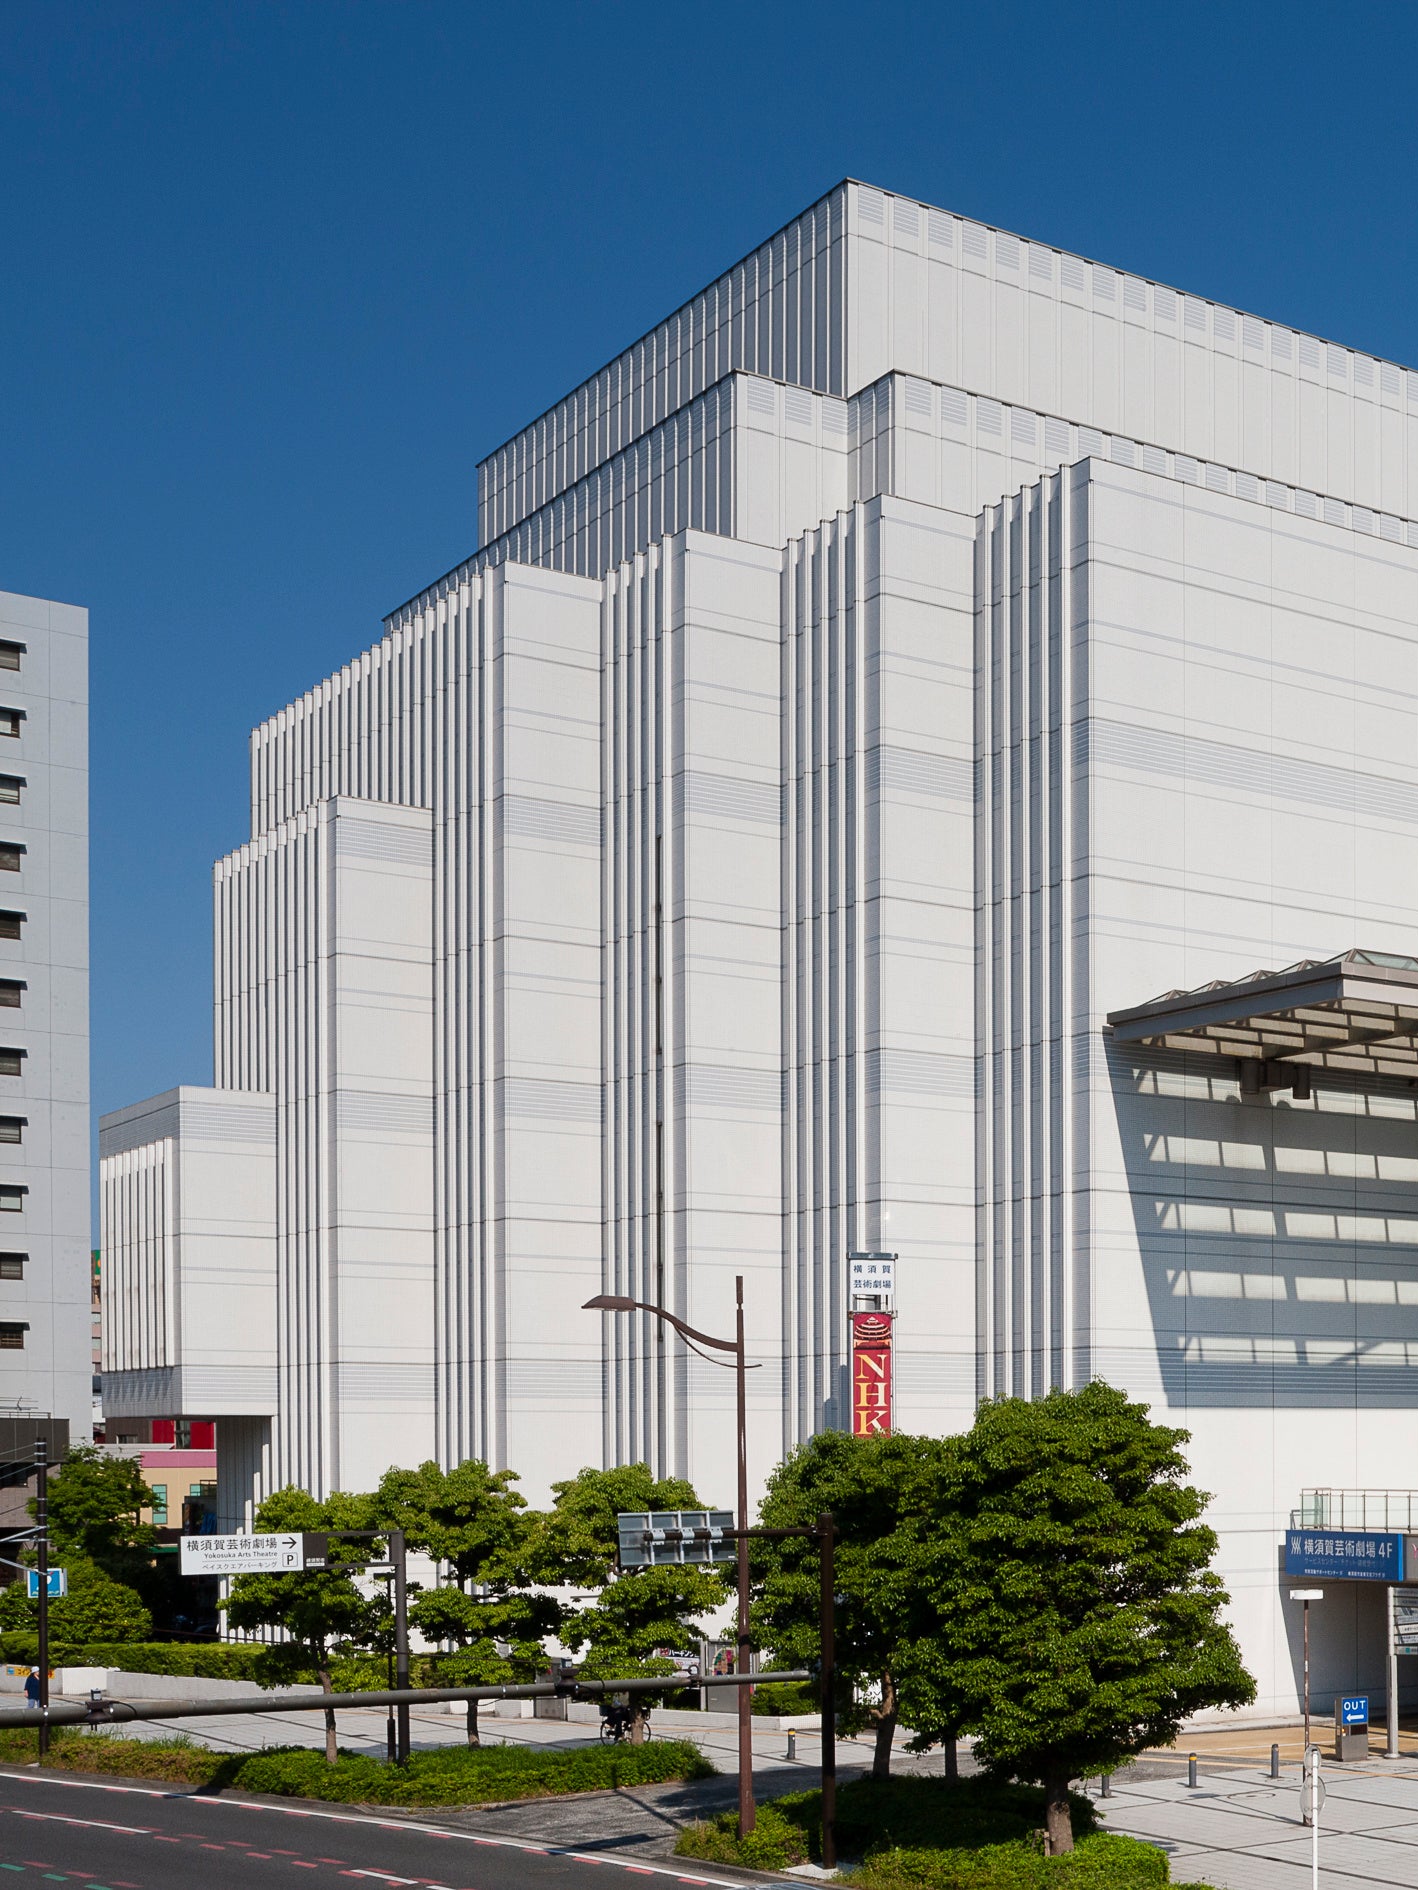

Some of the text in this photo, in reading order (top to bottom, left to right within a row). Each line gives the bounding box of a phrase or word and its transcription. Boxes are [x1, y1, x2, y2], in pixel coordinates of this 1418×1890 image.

[853, 1264, 891, 1273] 横須賀
[853, 1279, 892, 1289] 芸術劇場
[186, 1537, 278, 1551] 横須賀芸術劇場
[1304, 1538, 1393, 1559] 横須賀芸術劇場 4F
[1343, 1699, 1366, 1711] OUT
